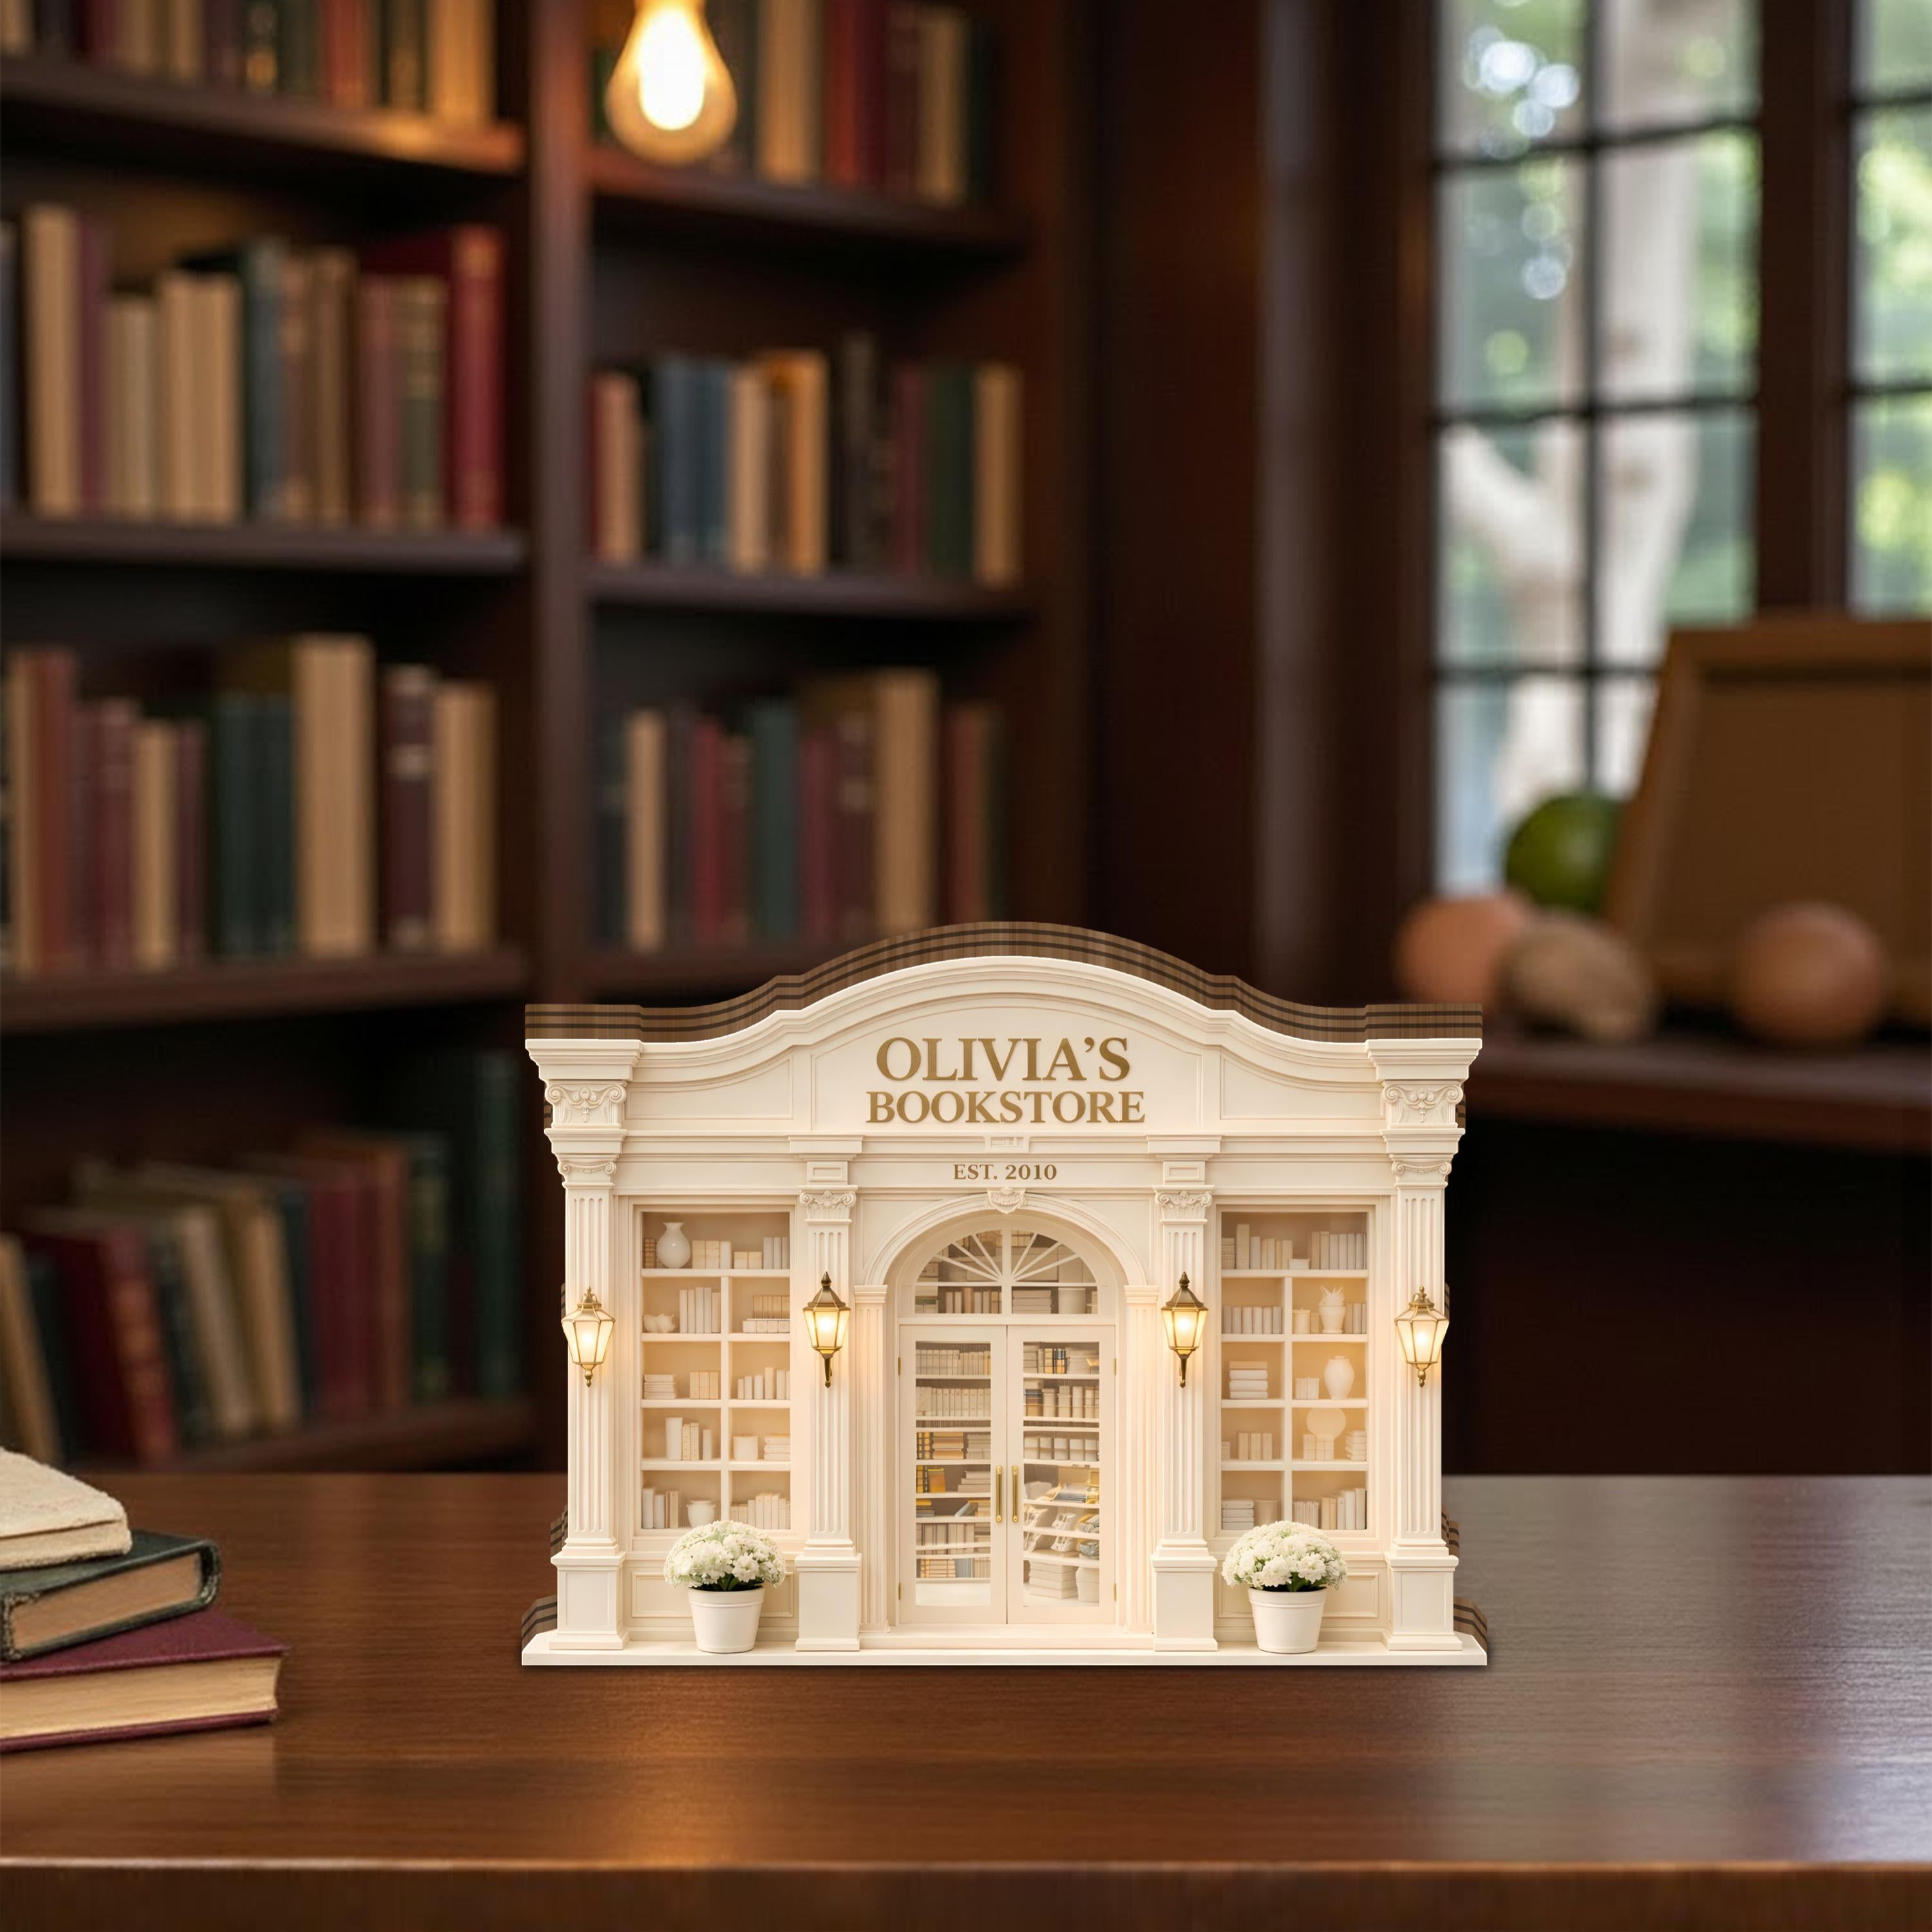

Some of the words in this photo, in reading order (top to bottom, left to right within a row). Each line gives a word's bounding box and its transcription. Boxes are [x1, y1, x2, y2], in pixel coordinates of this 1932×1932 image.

[876, 1036, 1131, 1082] OLIVIA’S
[866, 1090, 1146, 1124] BOOKSTORE
[953, 1164, 998, 1180] EST.
[1005, 1164, 1057, 1180] 2010
